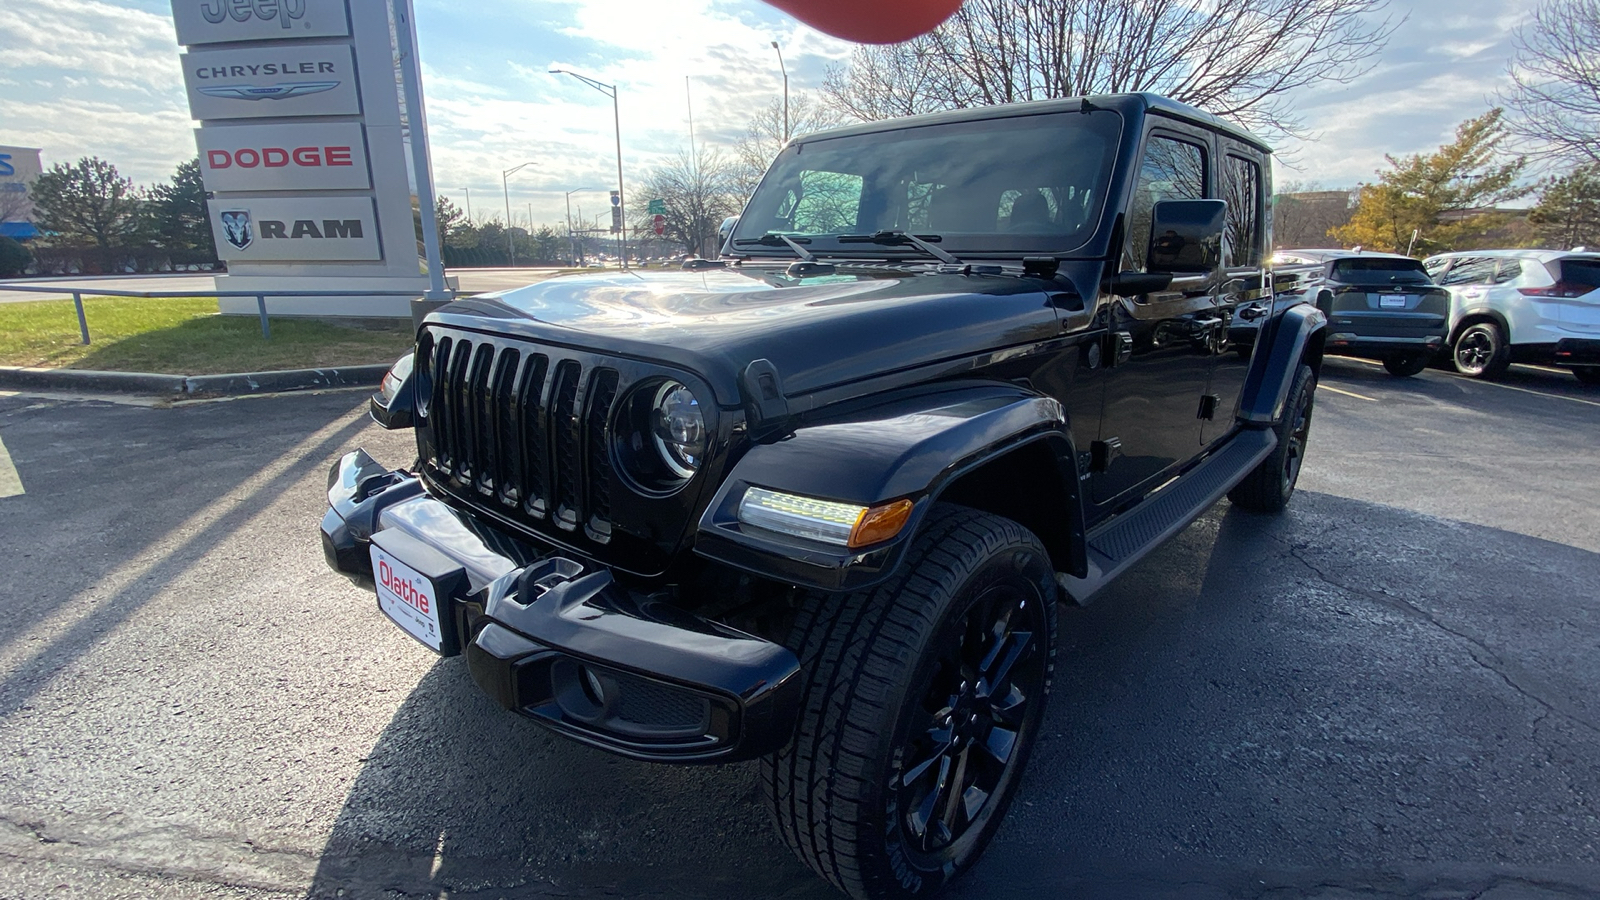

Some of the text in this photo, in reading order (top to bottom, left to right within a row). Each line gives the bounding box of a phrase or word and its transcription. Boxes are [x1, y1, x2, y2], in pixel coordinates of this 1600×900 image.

[201, 0, 305, 29] Jeep
[196, 62, 335, 79] CHRYSLER
[207, 146, 353, 169] DODGE
[258, 219, 363, 239] RAM
[379, 560, 429, 614] Olathe
